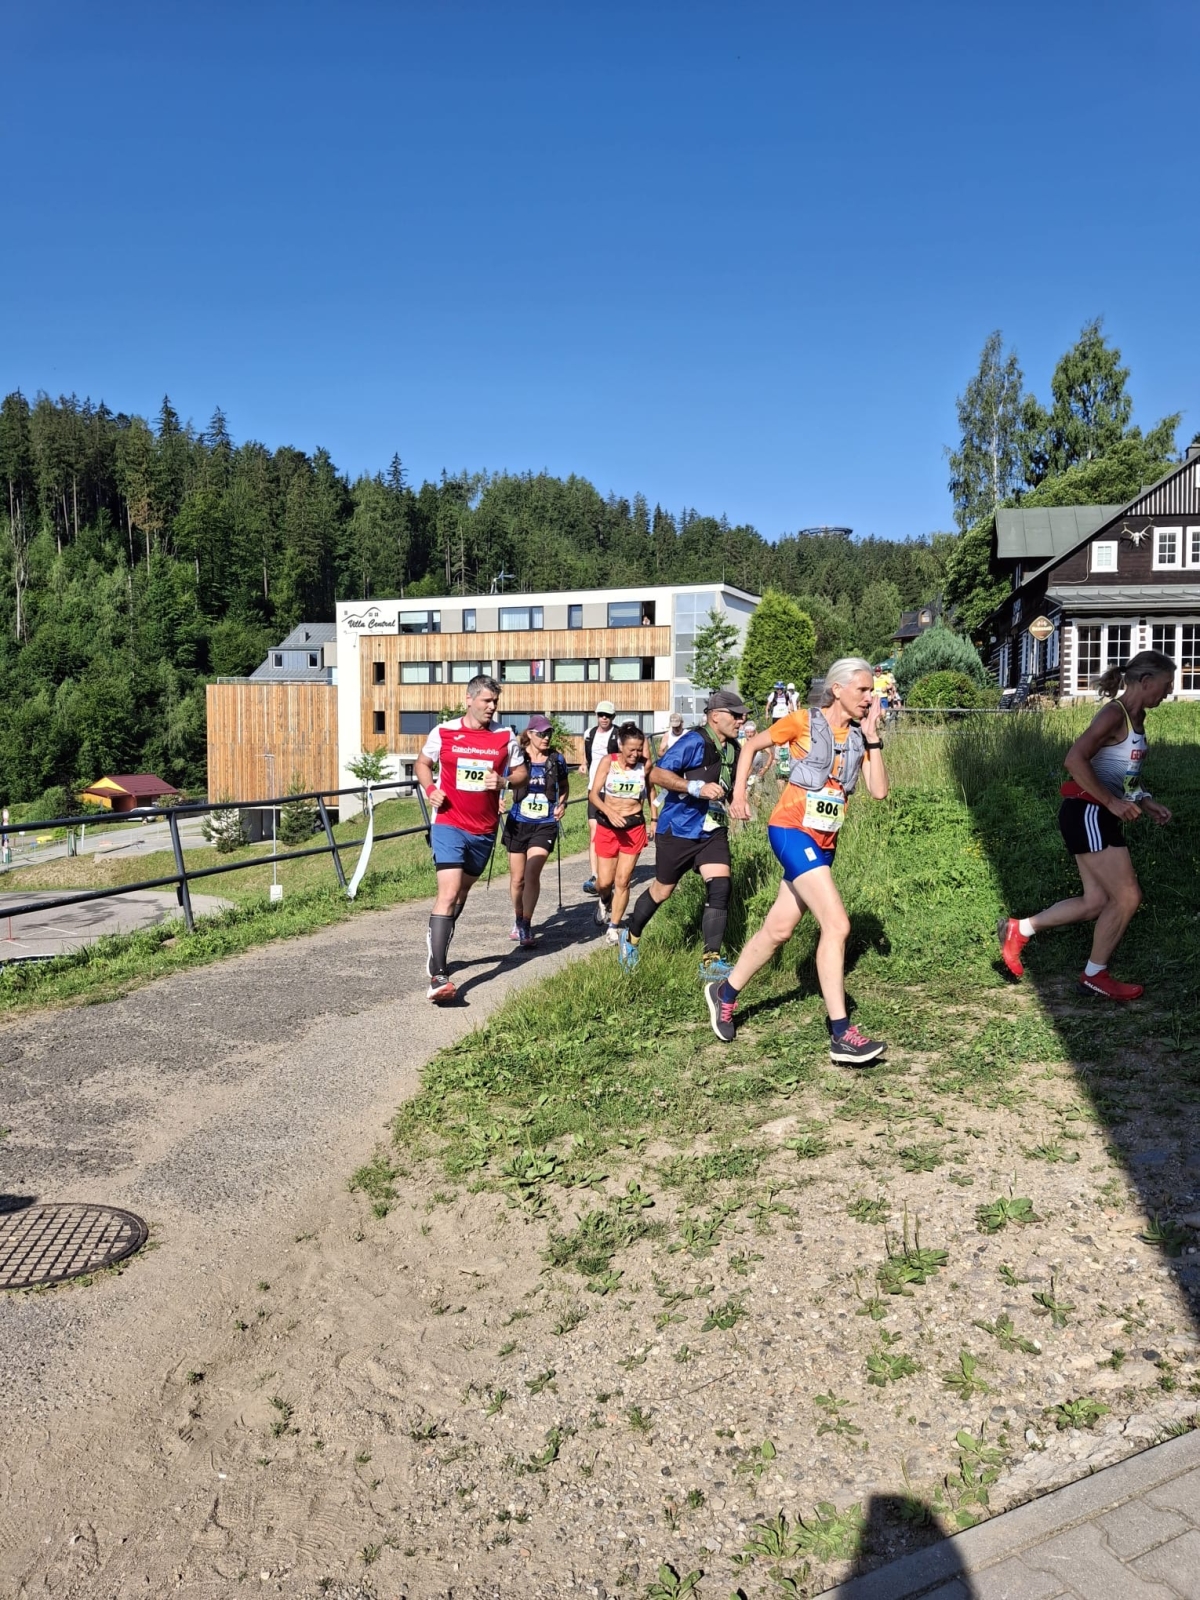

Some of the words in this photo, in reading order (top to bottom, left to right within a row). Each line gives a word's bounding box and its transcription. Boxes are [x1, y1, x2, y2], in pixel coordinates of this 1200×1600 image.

[348, 619, 366, 628] Villa
[367, 618, 396, 629] Central
[464, 769, 484, 781] 702
[619, 783, 635, 791] 717
[528, 802, 543, 812] 123
[815, 800, 839, 817] 806
